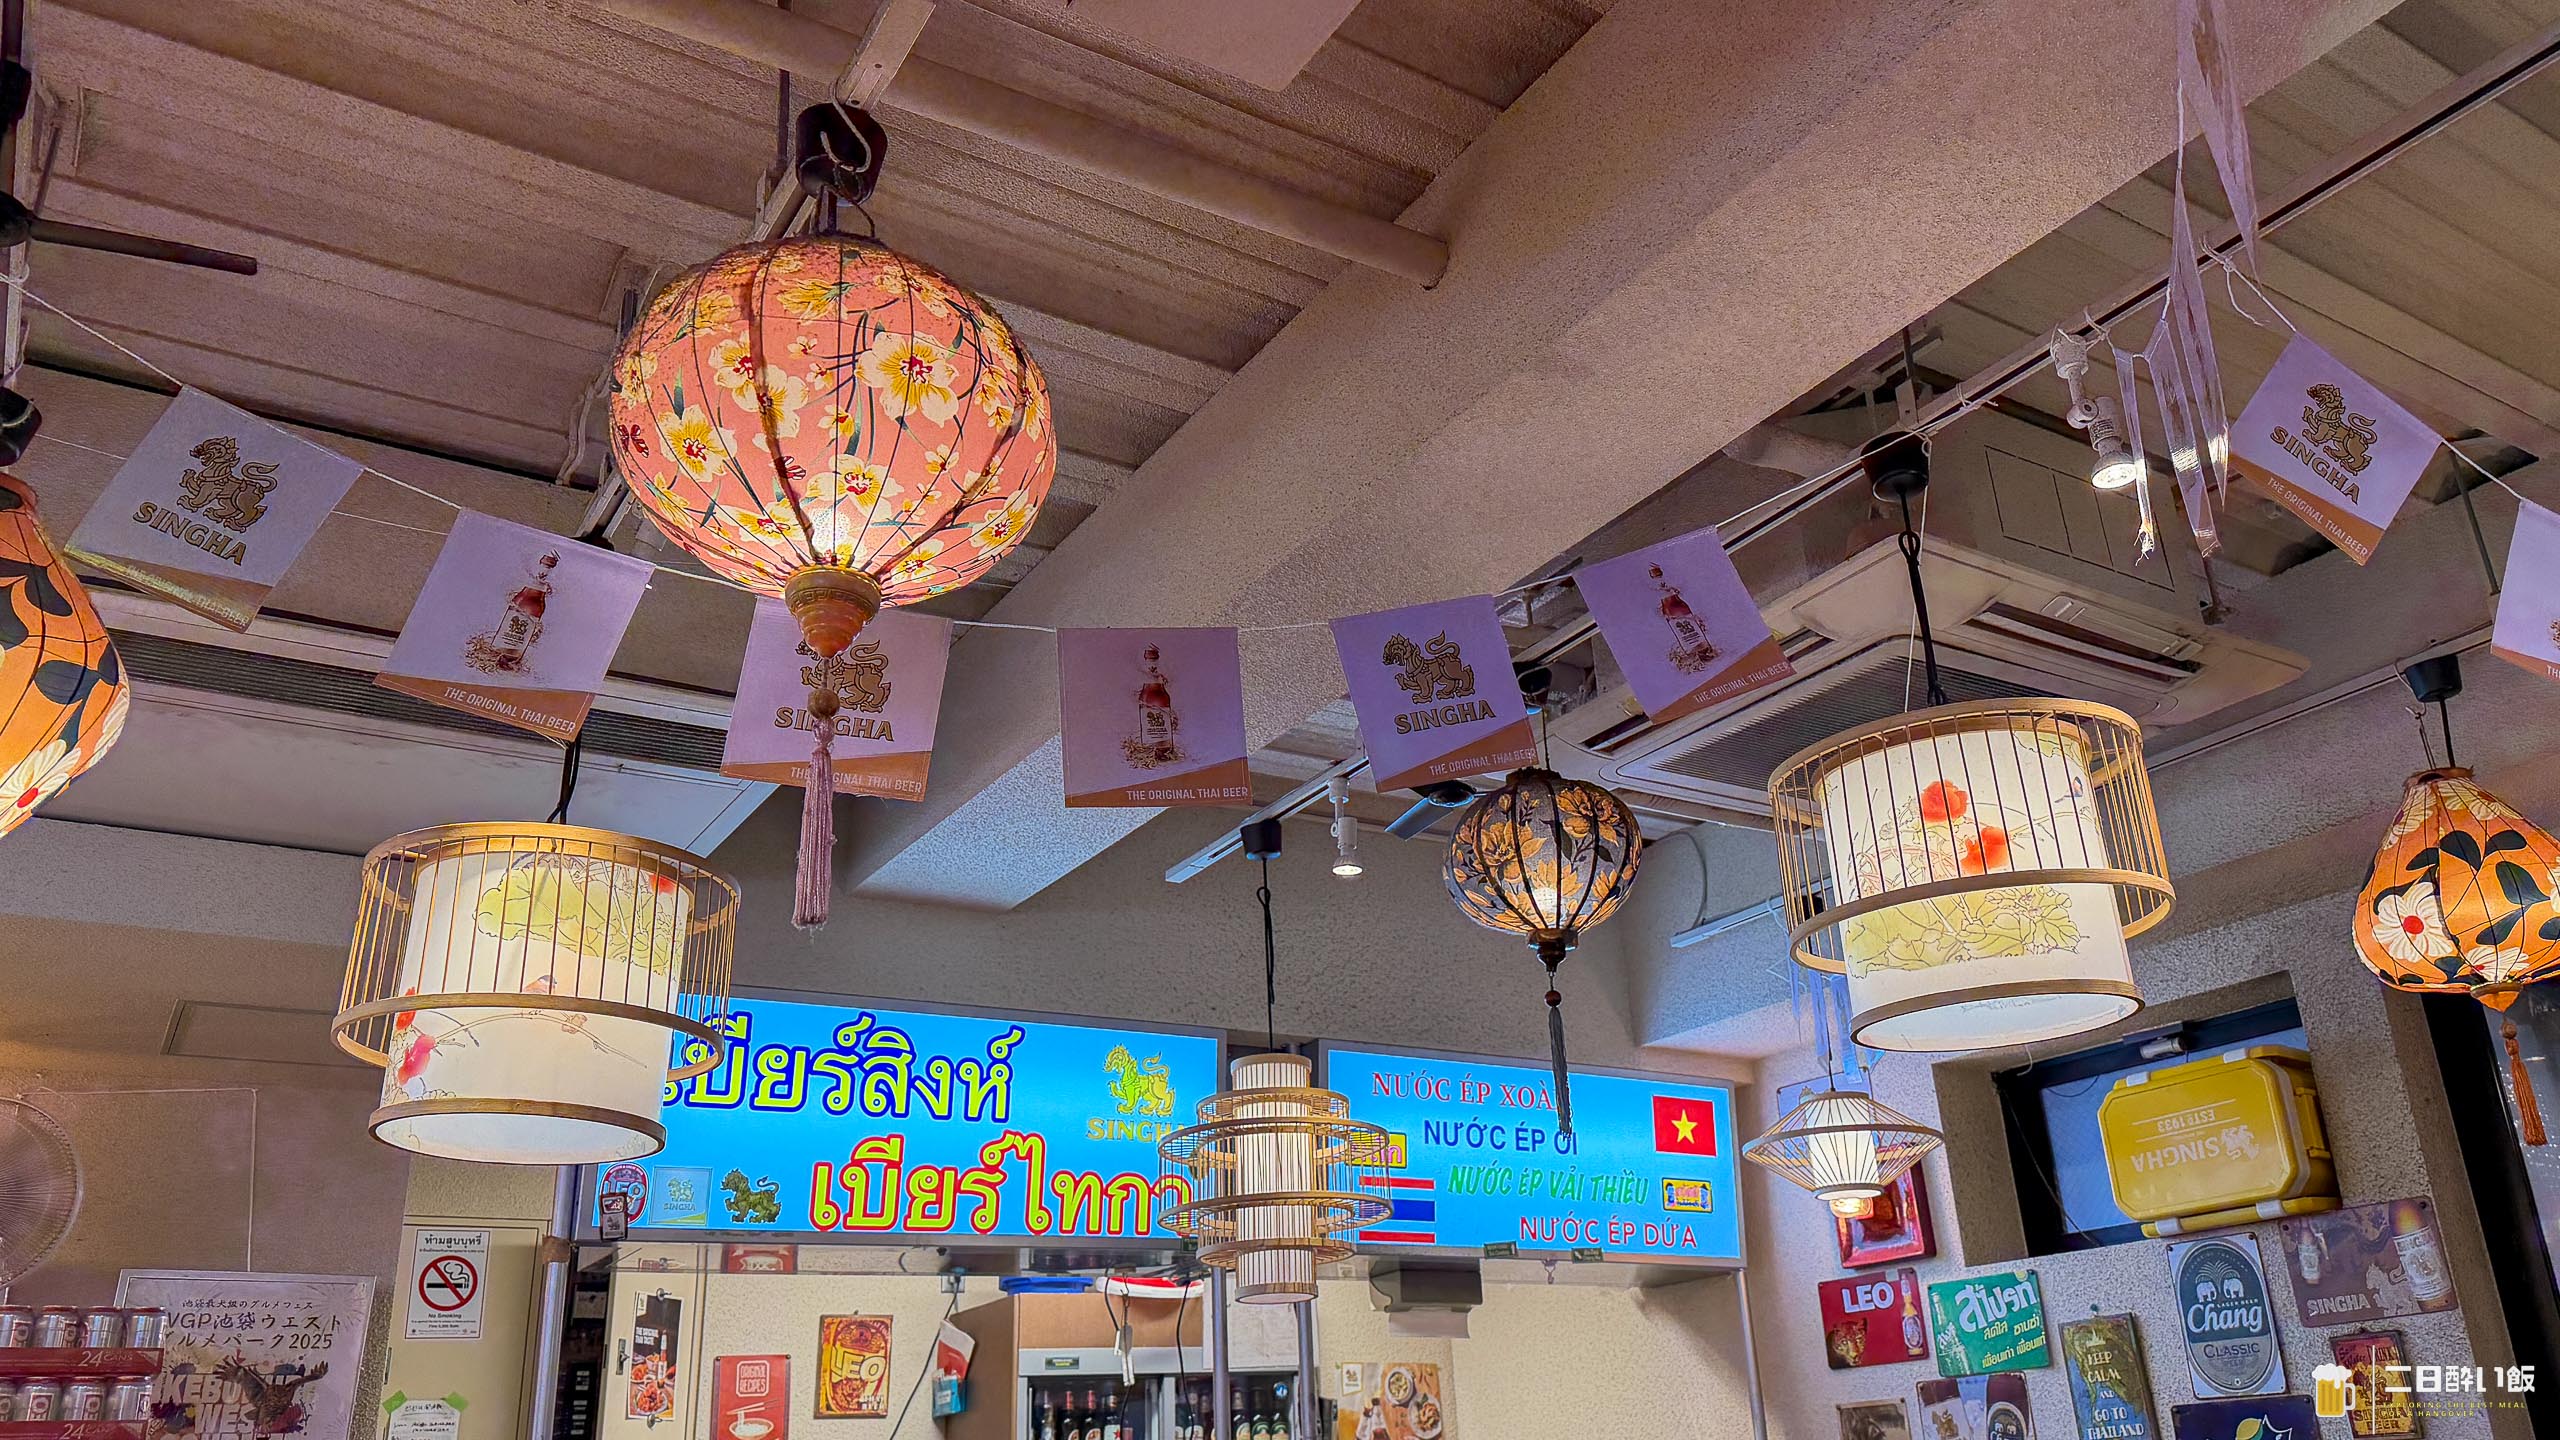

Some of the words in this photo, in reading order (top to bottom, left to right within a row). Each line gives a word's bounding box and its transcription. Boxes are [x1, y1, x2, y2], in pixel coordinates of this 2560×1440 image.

[2270, 425, 2361, 505] SINGHA
[2268, 476, 2285, 493] THE
[2283, 486, 2325, 524] ORIGINAL
[2324, 519, 2347, 542] THAI
[2344, 535, 2369, 558] BEER
[132, 501, 248, 567] SINGHA
[1693, 692, 1711, 704] THE
[1710, 678, 1749, 698] ORIGINAL
[1747, 671, 1769, 684] THAI
[1767, 661, 1791, 677] BEER
[444, 686, 464, 703] THE
[466, 693, 517, 718] ORIGINAL
[520, 708, 546, 725] THAI
[547, 715, 576, 734] BEER
[1394, 700, 1497, 735] SINGHA
[1429, 763, 1448, 776] THE
[1449, 756, 1492, 772] ORIGINAL
[1491, 752, 1514, 765] THAI
[867, 775, 892, 789] THAI
[894, 779, 923, 793] BEER
[1126, 790, 1146, 800] THE
[1148, 788, 1196, 800] ORIGINAL
[1198, 787, 1221, 798] THAI
[1223, 786, 1249, 798] BEER
[1372, 1070, 1451, 1102] NƯỚC
[1460, 1072, 1491, 1102] ÉP
[1499, 1080, 1557, 1112] XOÀ
[1423, 1116, 1506, 1151] NƯỚC
[1515, 1120, 1546, 1152] ÉP
[2157, 1116, 2186, 1133] 1933
[2130, 1136, 2220, 1173] SINGHA
[1448, 1159, 1513, 1196] NƯỚC
[1518, 1167, 1544, 1197] ÉP
[1549, 1165, 1585, 1201] VẢI
[663, 1203, 696, 1212] SINGHA
[1519, 1210, 1600, 1244] NƯỚC
[1608, 1214, 1637, 1246] ÉP
[1644, 1218, 1697, 1248] DỨA
[1842, 1281, 1895, 1314] LEO
[2307, 1294, 2371, 1317] SINGHA
[2187, 1303, 2263, 1333] Chang
[165, 1332, 333, 1350] ルメパーク2025
[78, 1350, 103, 1367] 24
[831, 1345, 887, 1383] LEO
[2087, 1351, 2112, 1365] KEEP
[739, 1379, 766, 1393] RECIPES
[2088, 1368, 2121, 1383] CALM
[2101, 1390, 2115, 1399] AND
[2094, 1408, 2110, 1421] GO
[2111, 1407, 2128, 1420] TO
[60, 1424, 85, 1440] 24
[2087, 1423, 2144, 1440] THAILAND
